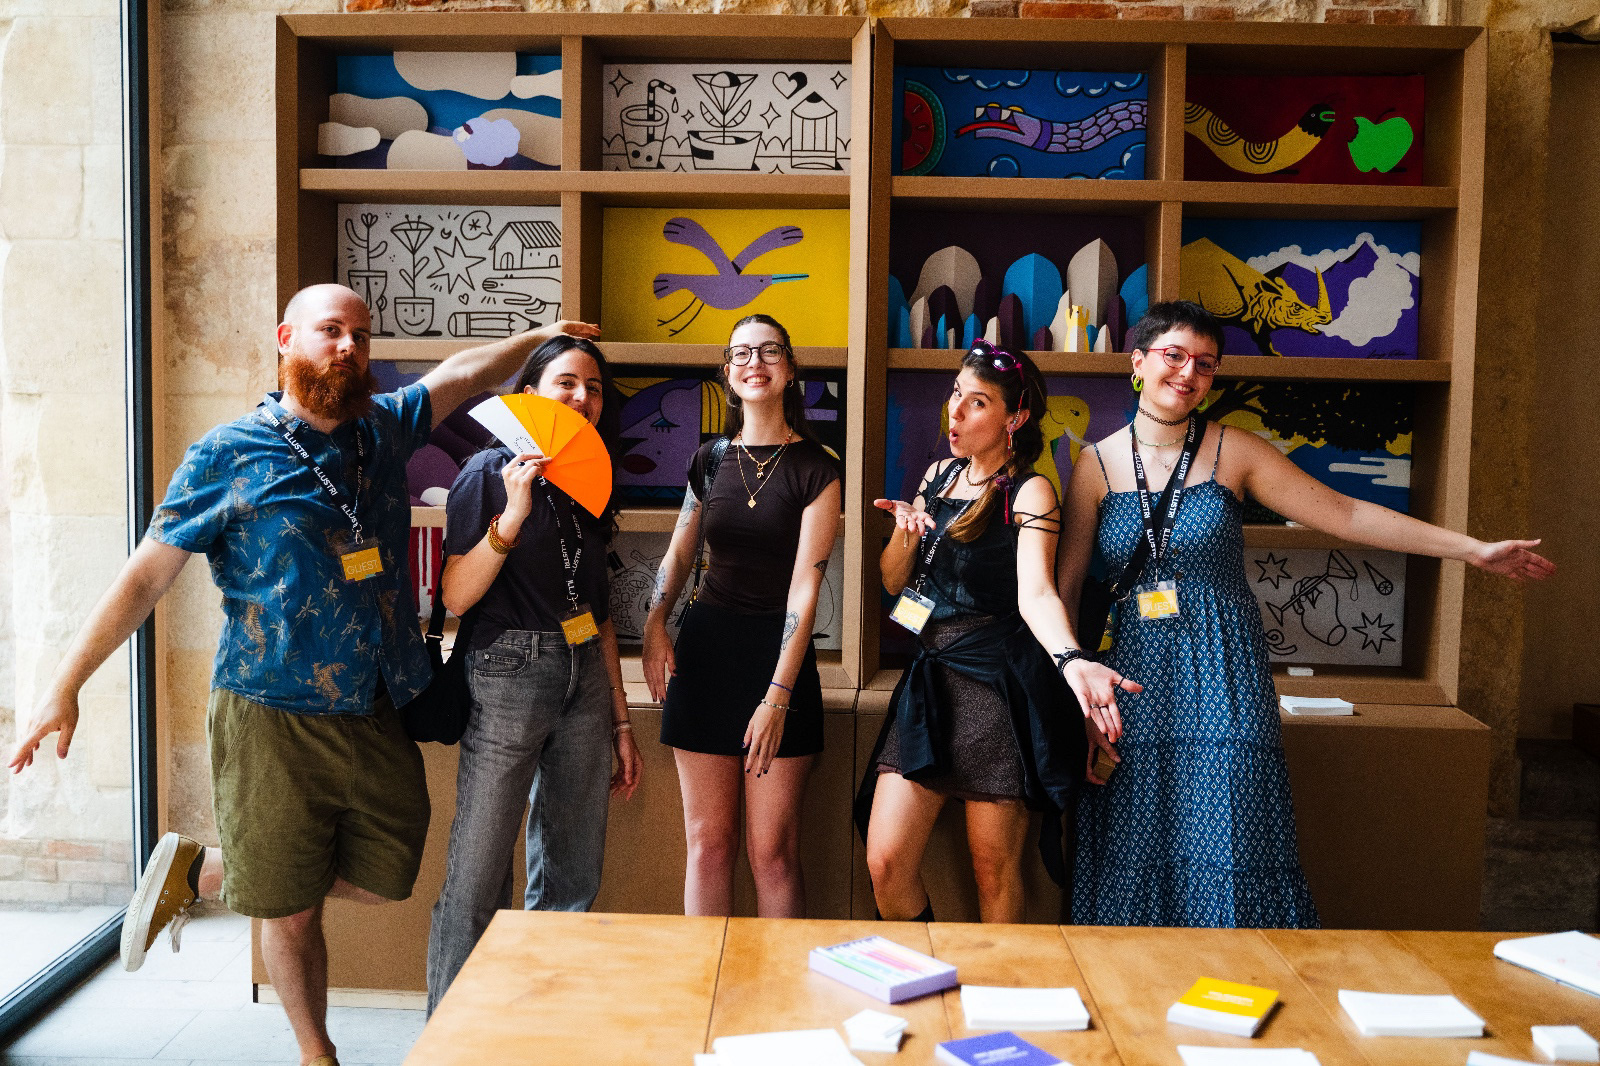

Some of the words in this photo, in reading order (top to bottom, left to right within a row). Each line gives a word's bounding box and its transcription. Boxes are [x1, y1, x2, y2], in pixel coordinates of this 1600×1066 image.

[1187, 416, 1196, 443] ILLUSTRI
[282, 432, 310, 459] ILLUSTRI
[1134, 451, 1144, 479] ILLUSTRI
[1177, 450, 1191, 480] ILLUSTRI
[313, 466, 339, 496] ILLUSTRI
[1139, 489, 1151, 519] ILLUSTRI
[1167, 488, 1181, 519] ILLUSTRI
[560, 538, 571, 569] ILLUSTRI
[925, 536, 941, 565] ILLUSTRI
[1158, 527, 1171, 558] ILLUSTRI
[346, 559, 378, 575] GUEST
[1141, 600, 1175, 613] GUEST
[567, 622, 594, 640] GUEST
